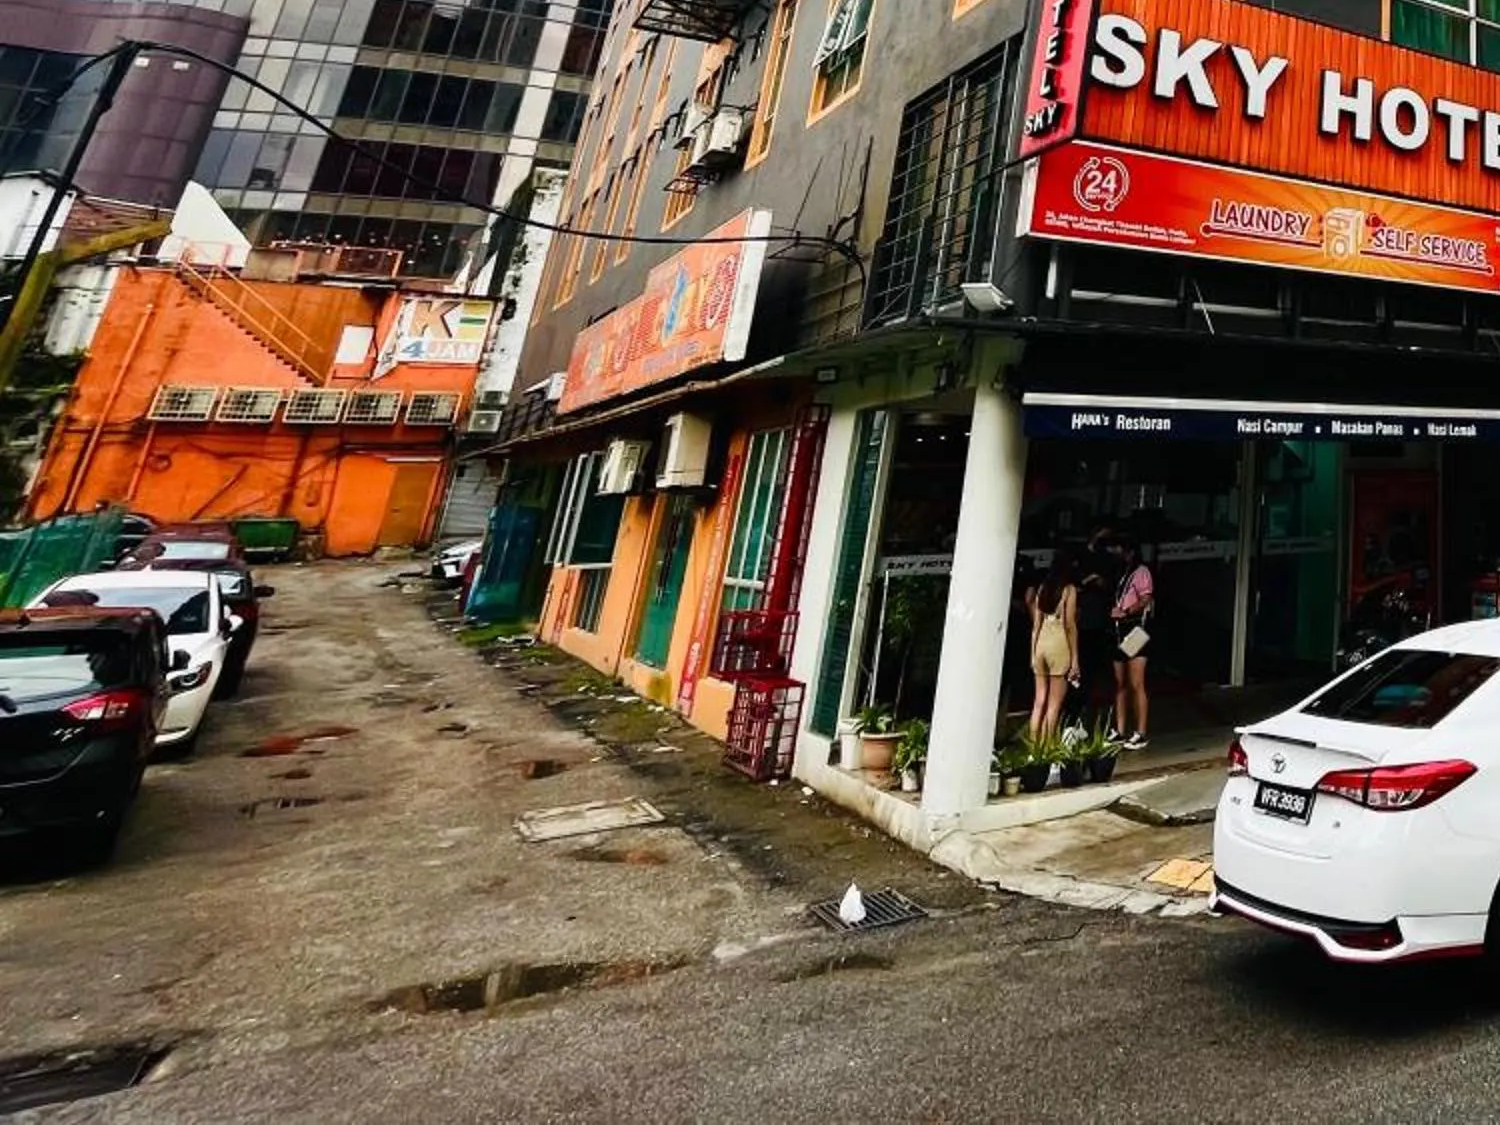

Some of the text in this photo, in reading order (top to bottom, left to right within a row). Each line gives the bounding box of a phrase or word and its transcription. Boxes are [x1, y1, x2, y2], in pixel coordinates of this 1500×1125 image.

[1091, 14, 1289, 119] SKY
[1024, 102, 1058, 135] SKY
[1086, 171, 1117, 194] 24
[1211, 198, 1487, 264] LAUNDRY SELF SERVICE
[1116, 414, 1171, 431] Restoran
[1237, 418, 1261, 433] Nasi
[1263, 419, 1304, 435] Campur
[1331, 420, 1374, 435] Masakan
